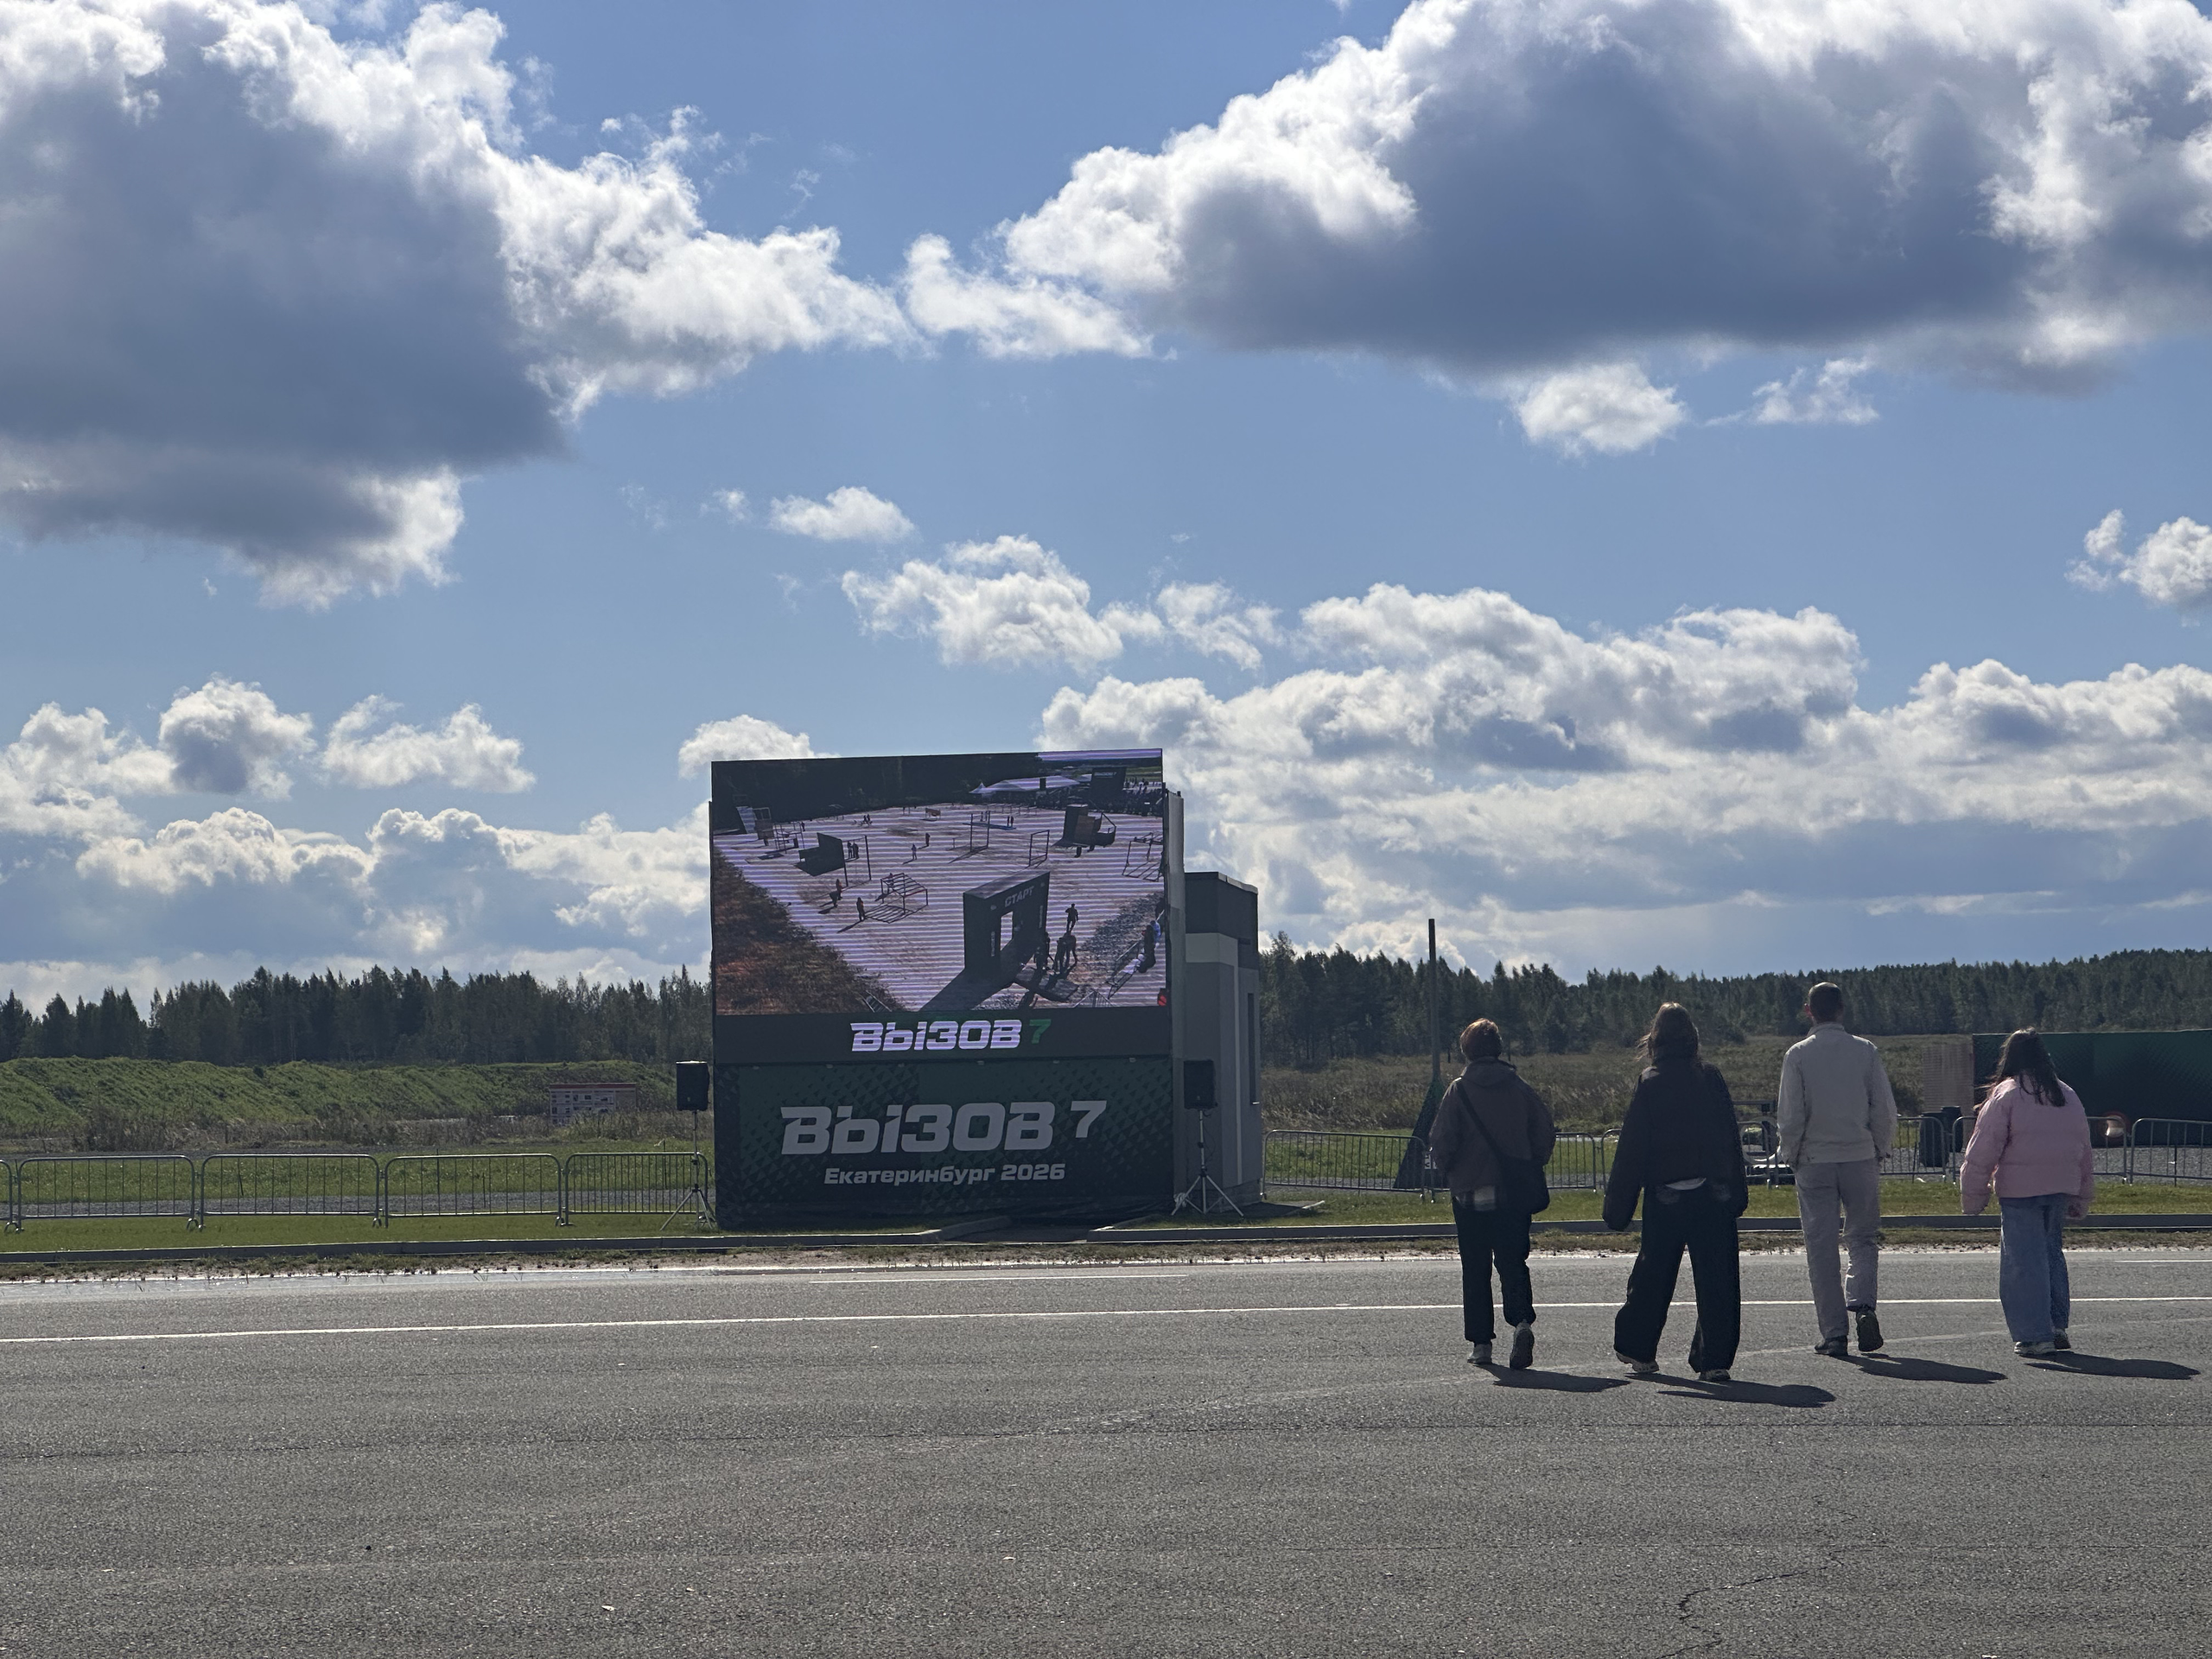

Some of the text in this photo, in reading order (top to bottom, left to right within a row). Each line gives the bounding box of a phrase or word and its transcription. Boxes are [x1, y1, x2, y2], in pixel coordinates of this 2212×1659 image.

[1004, 886, 1035, 908] СТАРТ
[849, 1019, 1052, 1052] ВЫЗОВ 7
[780, 1100, 1107, 1155] ВЫЗОВ 7
[823, 1163, 1066, 1186] Екатеринбург 2026
